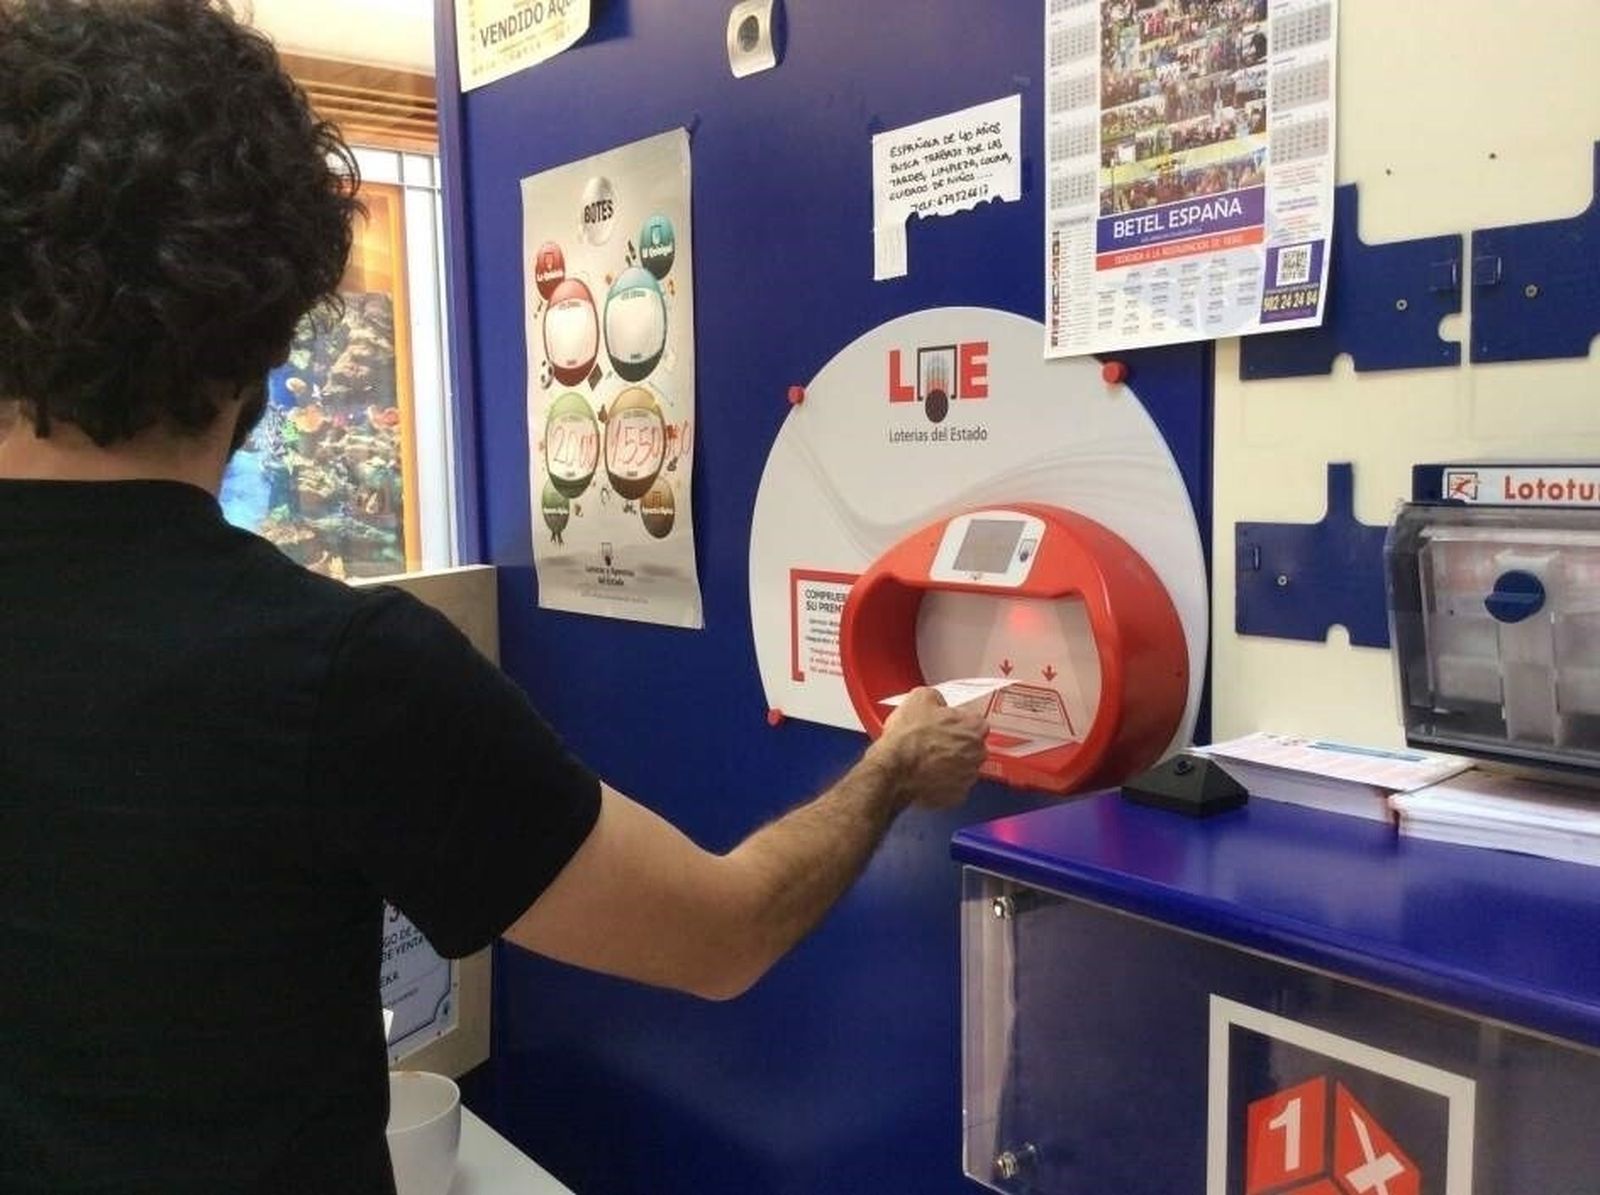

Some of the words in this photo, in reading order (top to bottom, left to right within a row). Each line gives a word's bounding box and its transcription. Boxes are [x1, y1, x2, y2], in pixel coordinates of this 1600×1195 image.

[480, 3, 543, 48] VENDIDO
[943, 133, 954, 145] DE
[976, 122, 1001, 134] AÑOS
[891, 160, 920, 173] BUSCA
[967, 143, 984, 155] POR
[988, 139, 1002, 150] LAS
[584, 199, 614, 224] BOTES
[1113, 214, 1165, 239] BETEL
[1169, 197, 1243, 229] ESPAÑA
[931, 427, 948, 442] del
[950, 426, 988, 442] Estado
[1504, 474, 1600, 500] Lototu
[806, 601, 818, 611] SU
[1269, 1097, 1301, 1172] 1
